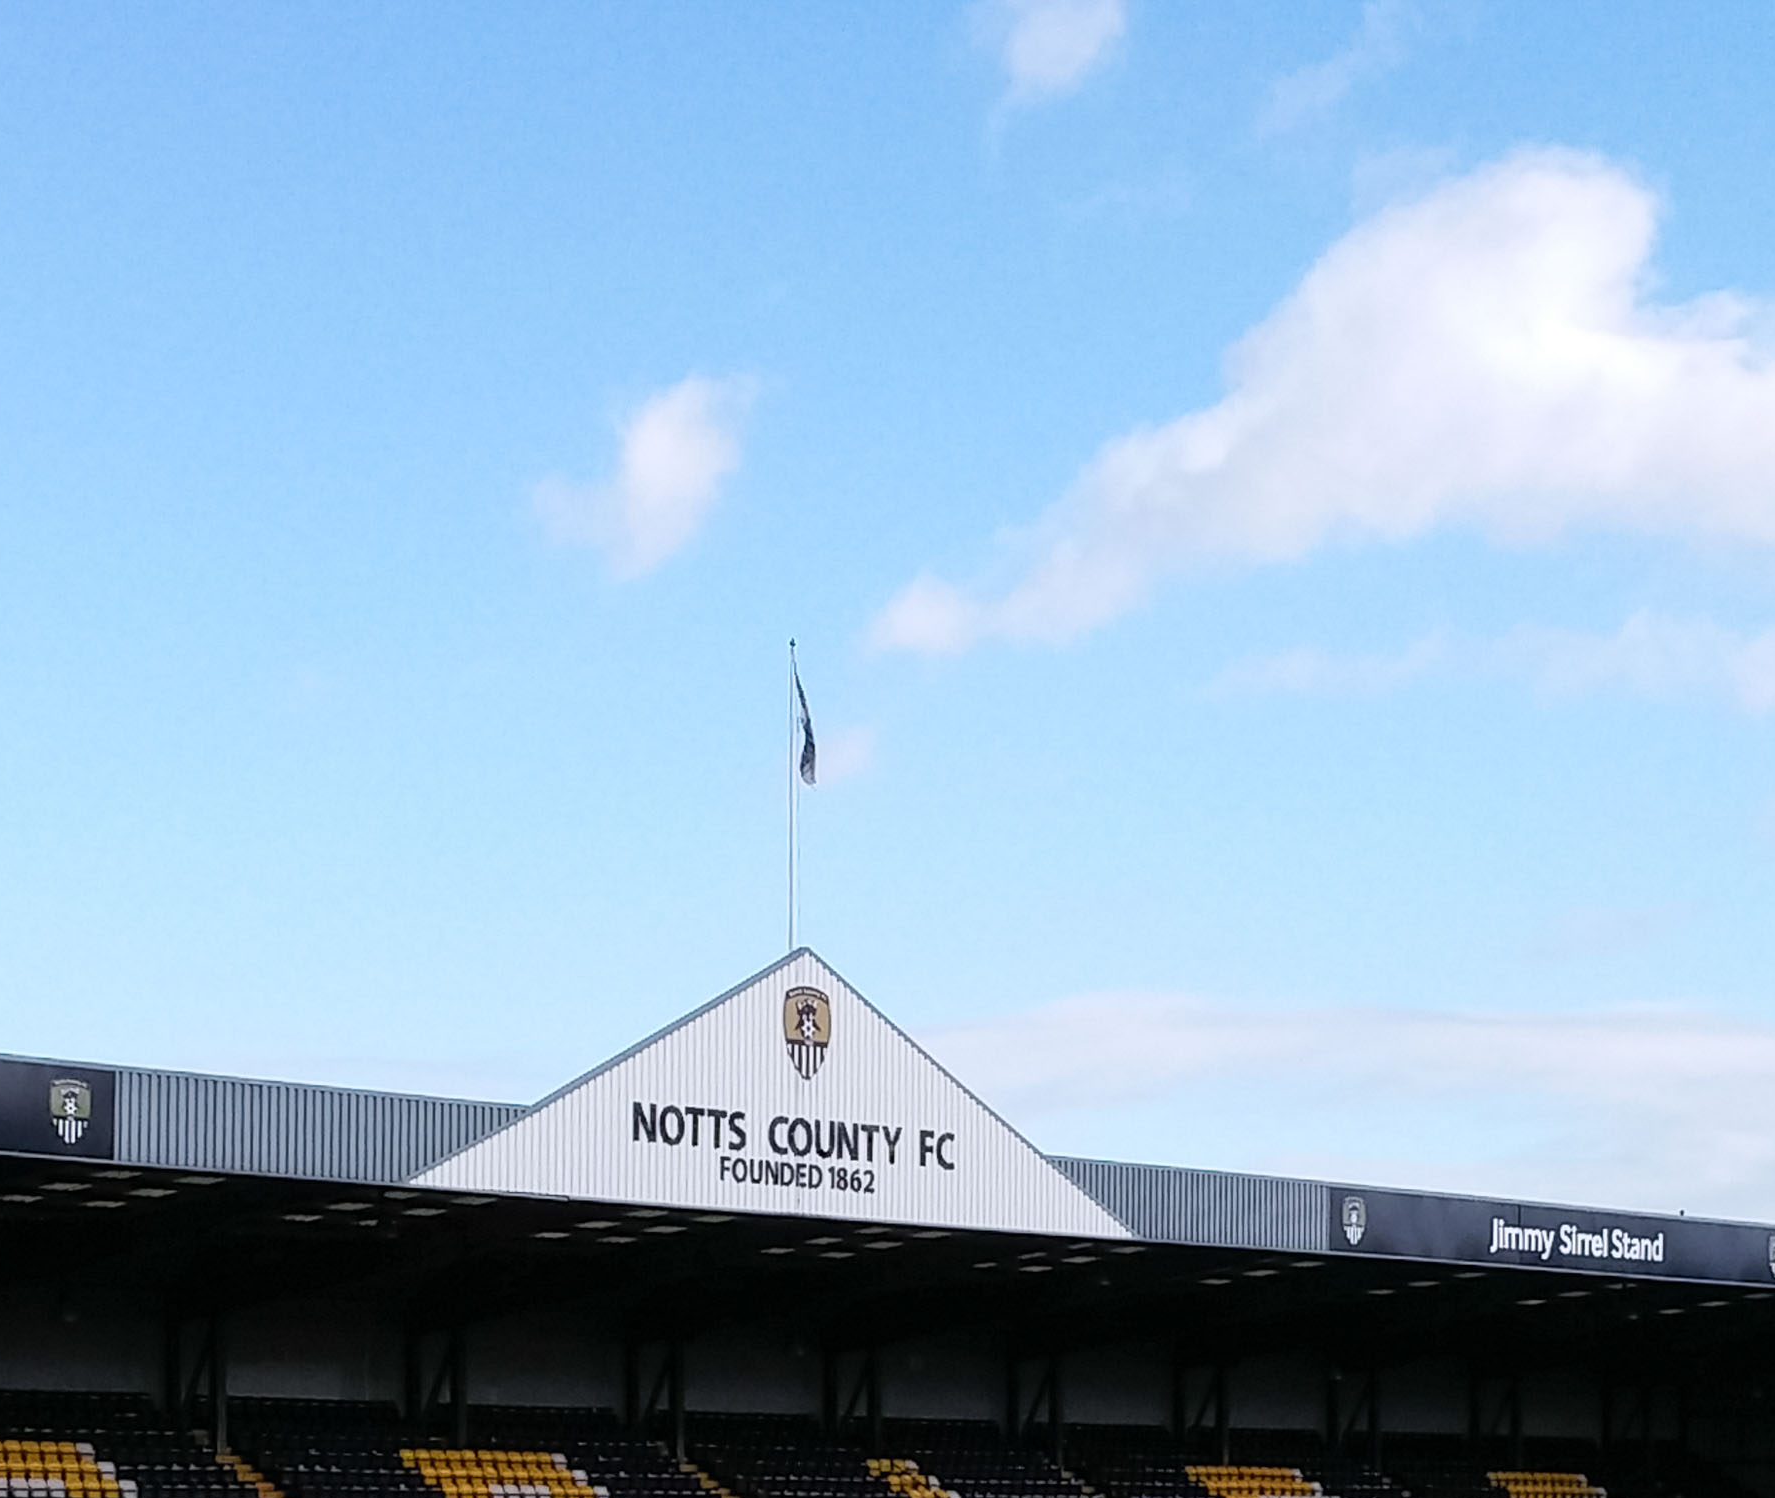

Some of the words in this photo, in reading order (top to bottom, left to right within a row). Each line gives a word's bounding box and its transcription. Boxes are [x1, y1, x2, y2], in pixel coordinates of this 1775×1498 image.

[632, 1102, 747, 1151] NOTTS
[768, 1116, 901, 1163] COUNTY
[919, 1130, 955, 1171] FC
[720, 1156, 823, 1190] FOUNDED
[828, 1165, 876, 1194] 1862
[1490, 1217, 1554, 1260] Jimmy
[1559, 1223, 1608, 1260] Sirrel
[1611, 1228, 1663, 1262] Stand
